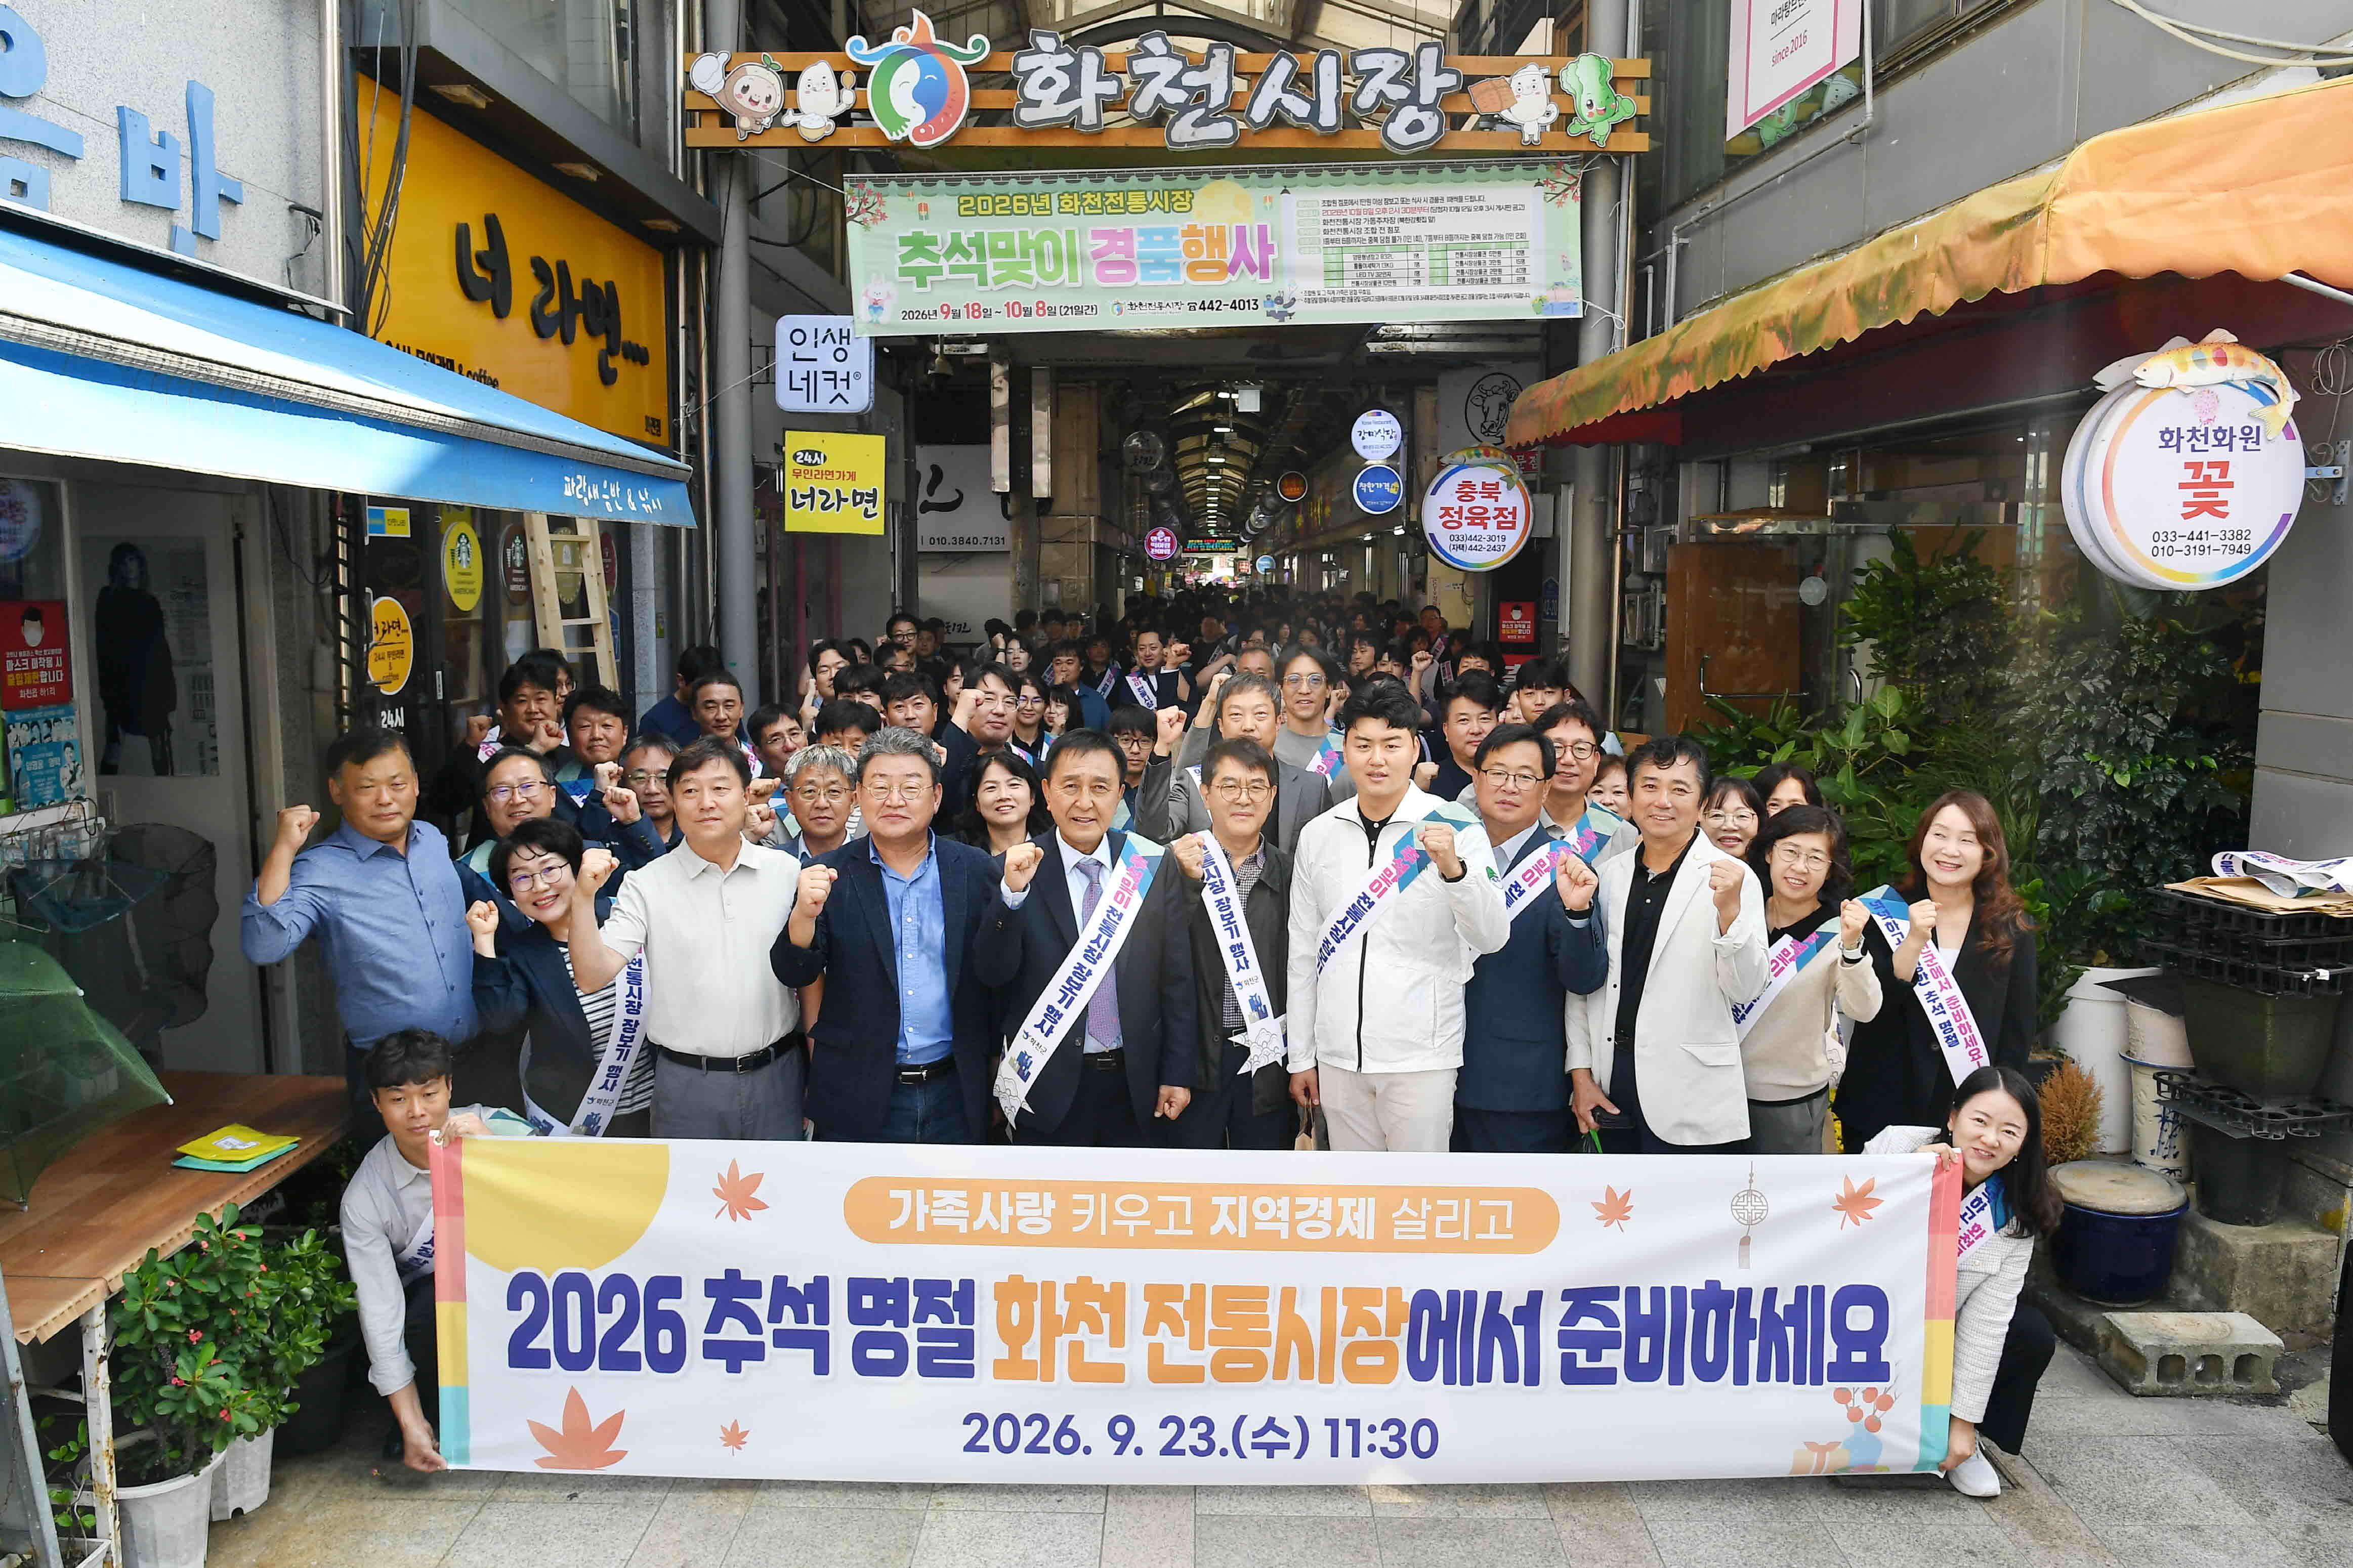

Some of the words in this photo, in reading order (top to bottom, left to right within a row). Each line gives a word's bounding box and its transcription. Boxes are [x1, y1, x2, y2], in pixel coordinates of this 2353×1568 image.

[1772, 50, 1789, 67] since
[1790, 30, 1808, 55] 2016
[1012, 29, 1462, 154] 화천시장
[958, 193, 1053, 218] 2026년
[1058, 189, 1194, 216] 화천전통시장
[1322, 218, 1362, 226] 화천전통시장
[1322, 227, 1362, 235] 화천전통시장
[1364, 227, 1377, 235] 조합
[455, 212, 513, 319] 너
[897, 228, 1081, 291] 추석맞이
[1089, 223, 1276, 285] 경품행사
[901, 309, 938, 321] 2026년
[940, 303, 961, 320] 9월
[963, 302, 993, 319] 18일
[1004, 301, 1033, 318] 10월
[1035, 300, 1057, 317] 8일
[1059, 304, 1098, 316] (21일간)
[1127, 301, 1185, 311] 화천전통시장
[1198, 299, 1259, 312] 442-4013
[789, 327, 851, 363] 인생
[788, 370, 851, 405] 네컷
[2158, 425, 2261, 453] 화천화원
[795, 451, 825, 465] 24시
[791, 469, 857, 482] 무인라면가게
[1455, 480, 1502, 502] 충북
[2178, 460, 2234, 520] 꽃
[563, 474, 600, 506] 파랑새
[602, 479, 623, 513] 음반
[627, 488, 637, 512] &
[638, 487, 662, 514] 낚시
[790, 486, 879, 519] 너라면
[1439, 505, 1518, 530] 정육점
[929, 536, 1006, 546] 010.3840.7131
[1448, 543, 1506, 554] (자택)442-2437
[1449, 534, 1506, 543] 033)442-3019
[2151, 543, 2251, 558] 010-3191-7949
[2152, 529, 2251, 543] 033-441-3382
[6, 658, 29, 672] 마스크
[56, 656, 63, 667] 시
[381, 706, 404, 729] 24시
[1080, 905, 1124, 965] 전통시장
[1214, 897, 1240, 940] 장보기
[1229, 943, 1250, 973] 행사
[1329, 891, 1375, 947] 전통시장
[1920, 942, 1952, 992] 군에서
[1058, 961, 1094, 1010] 장보기
[1034, 1004, 1064, 1038] 행사
[1924, 990, 1947, 1016] 추석
[1939, 1020, 1960, 1048] 명절
[615, 1019, 640, 1062] 장보기
[598, 1064, 623, 1092] 행사
[889, 1189, 1056, 1235] 가족사랑
[1072, 1193, 1194, 1237] 키우고
[1210, 1194, 1376, 1240] 지역경제
[1392, 1197, 1514, 1241] 살리고
[507, 1271, 687, 1374] 2026
[702, 1268, 830, 1376] 추석
[847, 1276, 976, 1380] 명절
[993, 1274, 1126, 1383] 화천
[1143, 1282, 1543, 1387] 전통시장에서
[1557, 1279, 1892, 1387] 준비하세요
[962, 1412, 1092, 1456] 2026.
[1106, 1414, 1144, 1456] 9.
[1158, 1413, 1310, 1460] 23.(수)
[1324, 1417, 1440, 1460] 11:30
